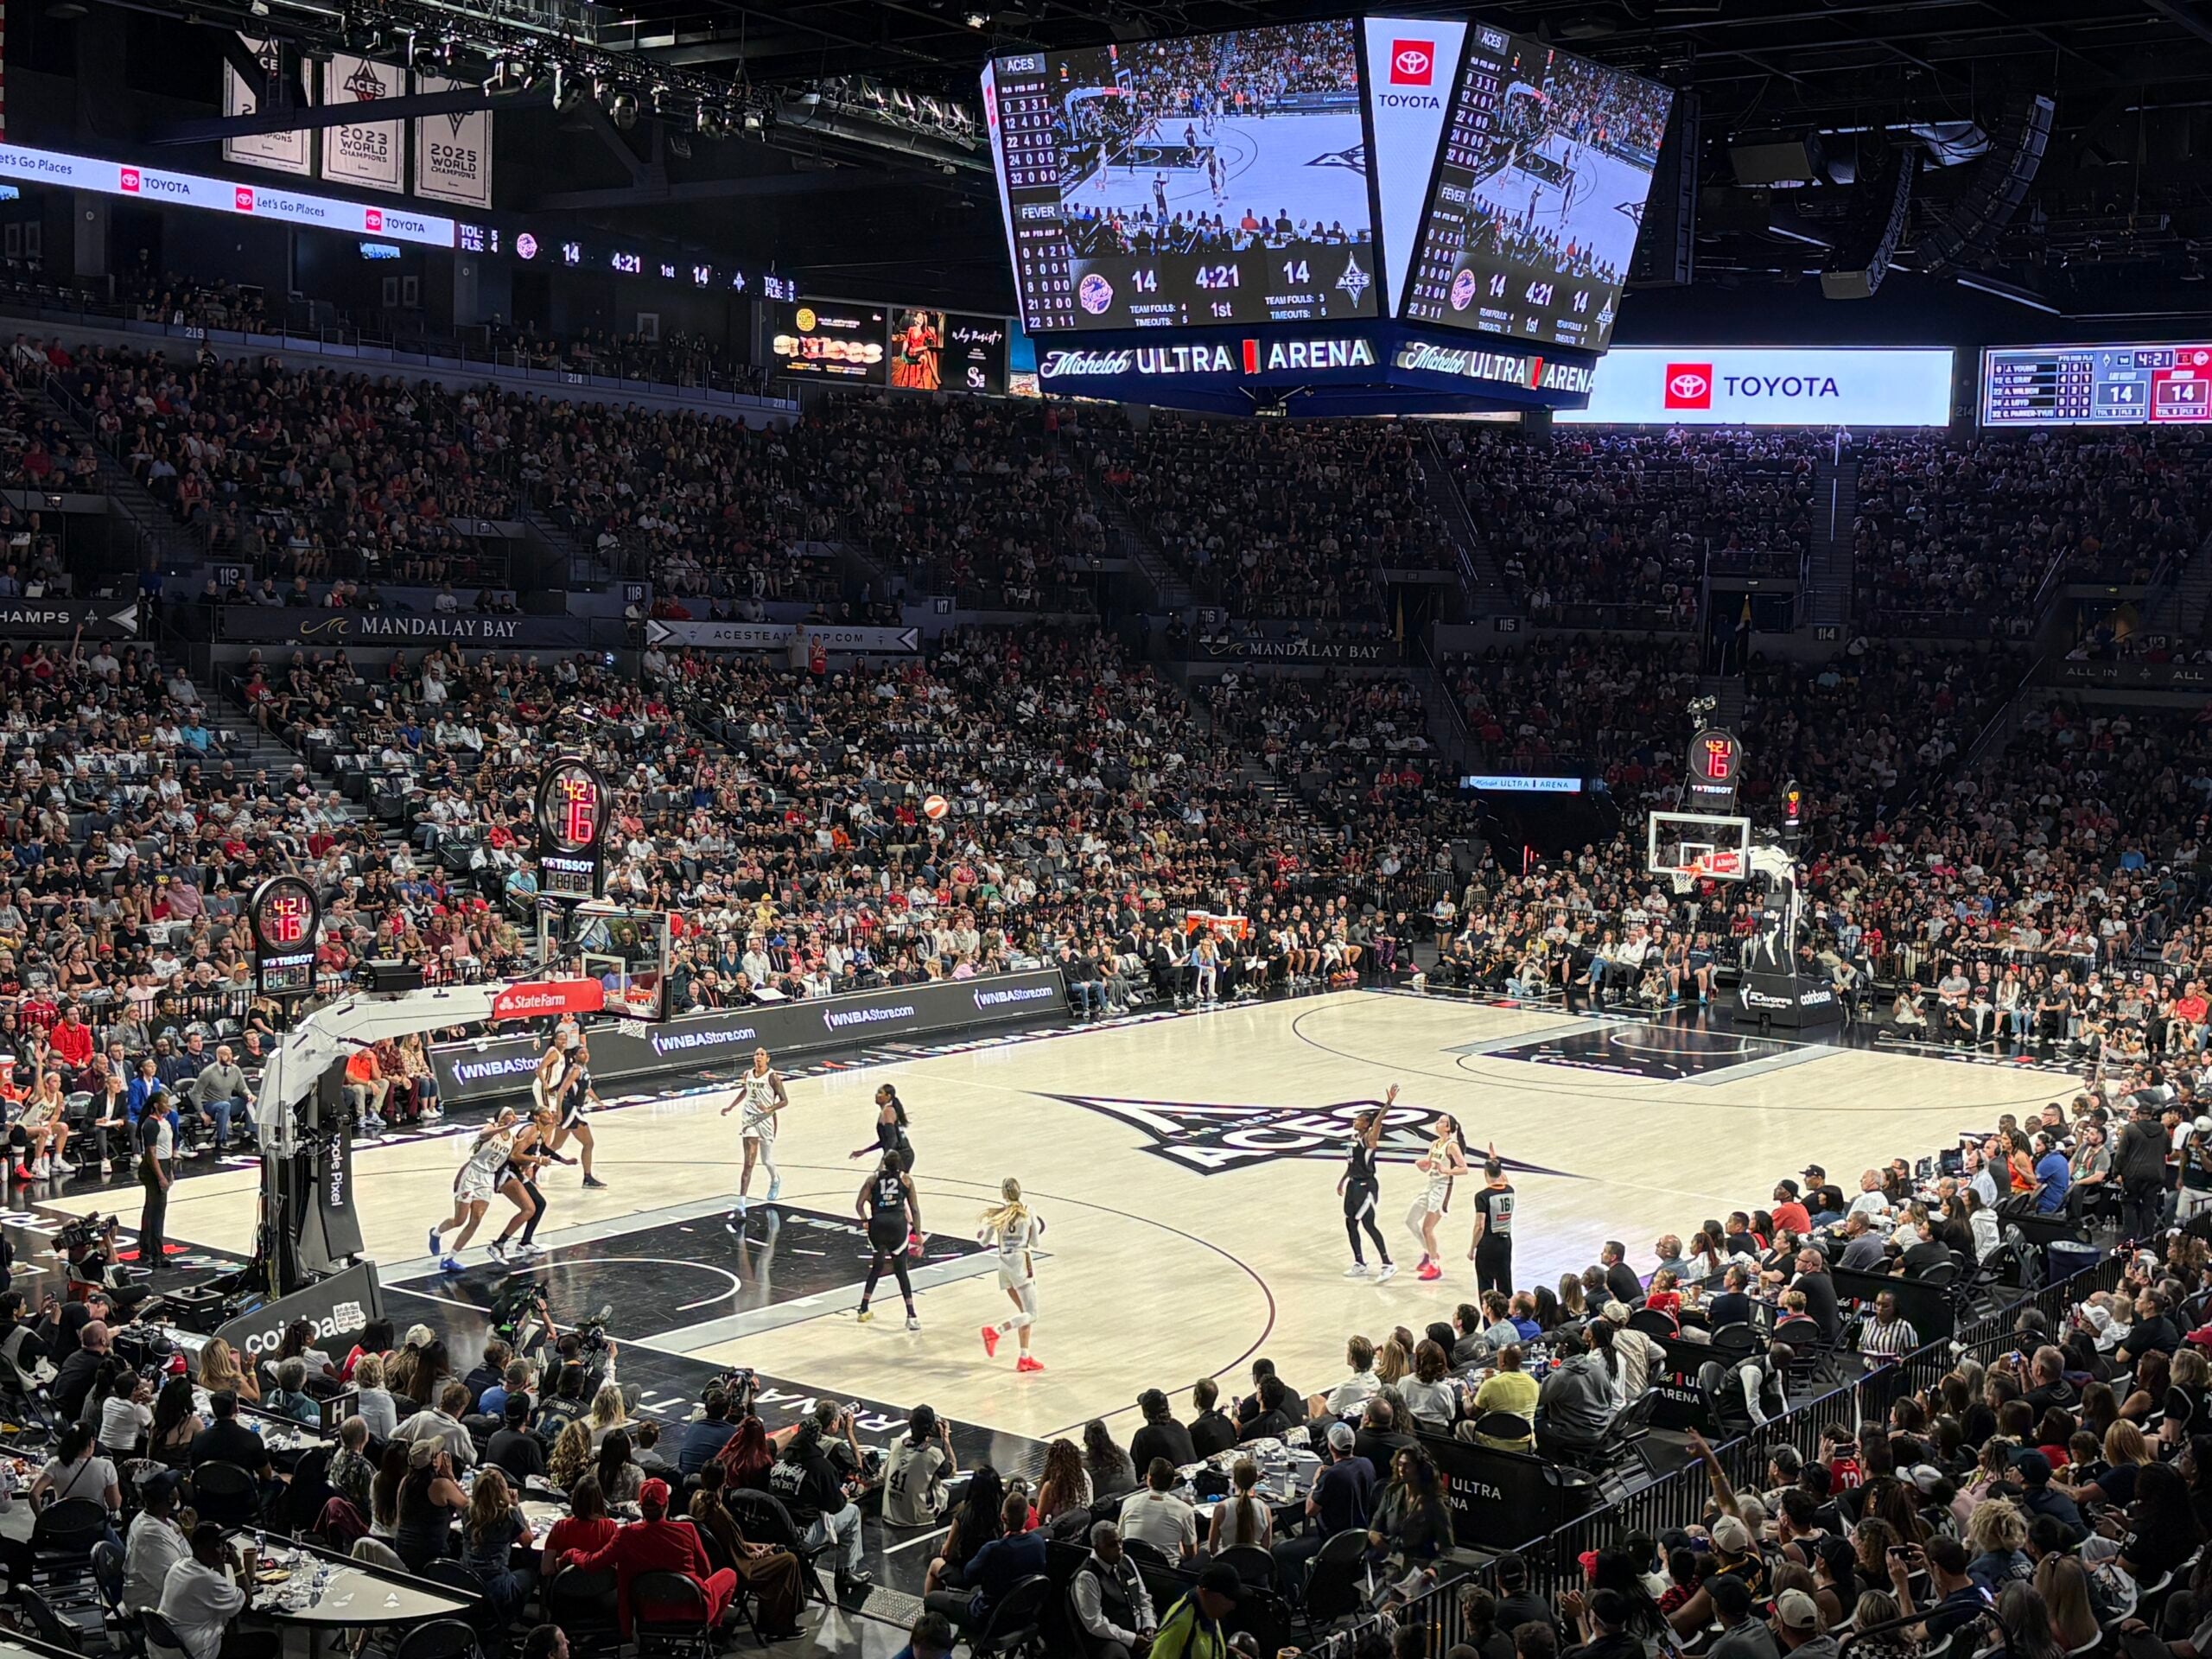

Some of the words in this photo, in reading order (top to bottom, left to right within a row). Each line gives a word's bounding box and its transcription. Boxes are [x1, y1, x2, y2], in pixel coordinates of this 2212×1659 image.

[1481, 31, 1502, 48] ACES
[1007, 58, 1034, 72] ACES
[346, 79, 385, 97] ACES
[1005, 102, 1011, 112] 0
[1020, 100, 1026, 111] 3
[1032, 99, 1038, 110] 3
[1043, 98, 1048, 109] 1
[1379, 94, 1440, 109] TOYOTA
[1005, 118, 1015, 129] 12
[1021, 117, 1027, 127] 4
[1033, 116, 1039, 126] 0
[1045, 115, 1050, 125] 1
[340, 126, 387, 145] 2023
[1007, 137, 1019, 148] 22
[1024, 135, 1030, 146] 4
[1036, 134, 1042, 145] 0
[1046, 133, 1052, 144] 0
[340, 149, 387, 162] CHAMPIONS
[341, 139, 387, 156] WORLD
[431, 143, 477, 162] 2025
[19, 156, 35, 168] Go
[38, 160, 72, 174] Places
[432, 156, 476, 172] WORLD
[1009, 155, 1020, 165] 24
[1027, 154, 1033, 165] 0
[1039, 152, 1045, 163] 0
[1048, 152, 1054, 162] 0
[431, 167, 476, 180] CHAMPIONS
[1011, 173, 1023, 183] 32
[1028, 172, 1034, 182] 0
[1040, 171, 1046, 181] 0
[1050, 170, 1056, 181] 0
[144, 178, 190, 194] TOYOTA
[1441, 187, 1466, 203] FEVER
[257, 198, 277, 210] Let's
[280, 201, 294, 213] Go
[296, 205, 325, 218] Places
[1022, 207, 1055, 219] FEVER
[385, 218, 425, 233] TOYOTA
[460, 225, 483, 238] TOL:
[491, 230, 498, 240] 5
[461, 240, 484, 251] FLS:
[491, 242, 498, 252] 4
[563, 244, 580, 263] 14
[1023, 248, 1030, 258] 0
[1038, 247, 1044, 257] 4
[1050, 246, 1056, 257] 2
[1061, 245, 1065, 256] 1
[612, 252, 641, 273] 4:21
[660, 264, 675, 278] 1st
[1282, 259, 1310, 284] 14
[693, 267, 709, 285] 14
[764, 276, 783, 289] TOL:
[788, 281, 794, 290] 5
[1132, 269, 1158, 293] 14
[1195, 264, 1240, 289] 4:21
[1338, 275, 1370, 286] ACES
[1490, 274, 1507, 297] 14
[1525, 281, 1554, 306] 4:21
[765, 288, 784, 300] FLS:
[788, 292, 794, 302] 3
[1265, 296, 1287, 305] TEAM
[1287, 295, 1314, 303] FOULS:
[1573, 290, 1589, 313] 14
[1028, 299, 1039, 310] 21
[1045, 299, 1051, 308] 2
[1056, 298, 1063, 308] 0
[1065, 297, 1071, 308] 0
[1129, 305, 1150, 314] TEAM
[1151, 304, 1176, 313] FOULS:
[1211, 302, 1232, 318] 1st
[1029, 317, 1041, 327] 22
[1046, 316, 1053, 327] 3
[1060, 316, 1065, 327] 1
[1069, 315, 1074, 326] 1
[1270, 309, 1311, 320] TIMEOUTS:
[1321, 308, 1326, 316] 5
[1135, 318, 1173, 327] TIMEOUTS:
[185, 327, 204, 340] 219
[1040, 349, 1131, 379] Michelob
[1137, 346, 1234, 375] ULTRA
[1268, 340, 1370, 369] ARENA
[2139, 353, 2170, 365] 4:21
[1405, 342, 1466, 374] Michelob
[1470, 352, 1526, 384] ULTRA
[568, 373, 582, 384] 218
[1544, 363, 1597, 392] ARENA
[1724, 376, 1839, 397] TOYOTA
[2111, 385, 2133, 402] 14
[2172, 385, 2194, 401] 14
[219, 568, 239, 586] 119
[626, 586, 643, 601] 118
[935, 599, 949, 613] 117
[361, 616, 476, 637] MANDALAY
[483, 620, 518, 638] BAY
[1499, 619, 1516, 632] 115
[1818, 627, 1836, 640] 114
[1250, 644, 1343, 658] MANDALAY
[1349, 645, 1381, 658] BAY
[2173, 671, 2203, 680] ALL
[1706, 740, 1732, 754] 4:21
[1708, 753, 1727, 777] 16
[563, 779, 596, 802] 4:21
[1703, 785, 1732, 794] TISSOT
[567, 802, 593, 842] 16
[556, 860, 594, 873] TISSOT
[274, 897, 307, 915] 4:21
[1764, 910, 1781, 921] ally
[280, 917, 302, 941] 16
[276, 954, 314, 966] TISSOT
[979, 986, 1052, 1006] WNBAStore.com
[1801, 989, 1831, 1006] coinbase
[830, 1004, 914, 1027] WNBAStore.com
[659, 1026, 756, 1051] WNBAStore.com
[1164, 1101, 1429, 1169] ACES
[330, 1172, 344, 1207] Pixel
[880, 1179, 899, 1194] 12
[1500, 1198, 1510, 1212] 16
[1754, 1305, 1765, 1325] A
[1659, 1387, 1700, 1405] ARENA
[332, 1401, 346, 1425] H
[890, 1470, 907, 1493] 41
[1452, 1477, 1501, 1500] ULTRA
